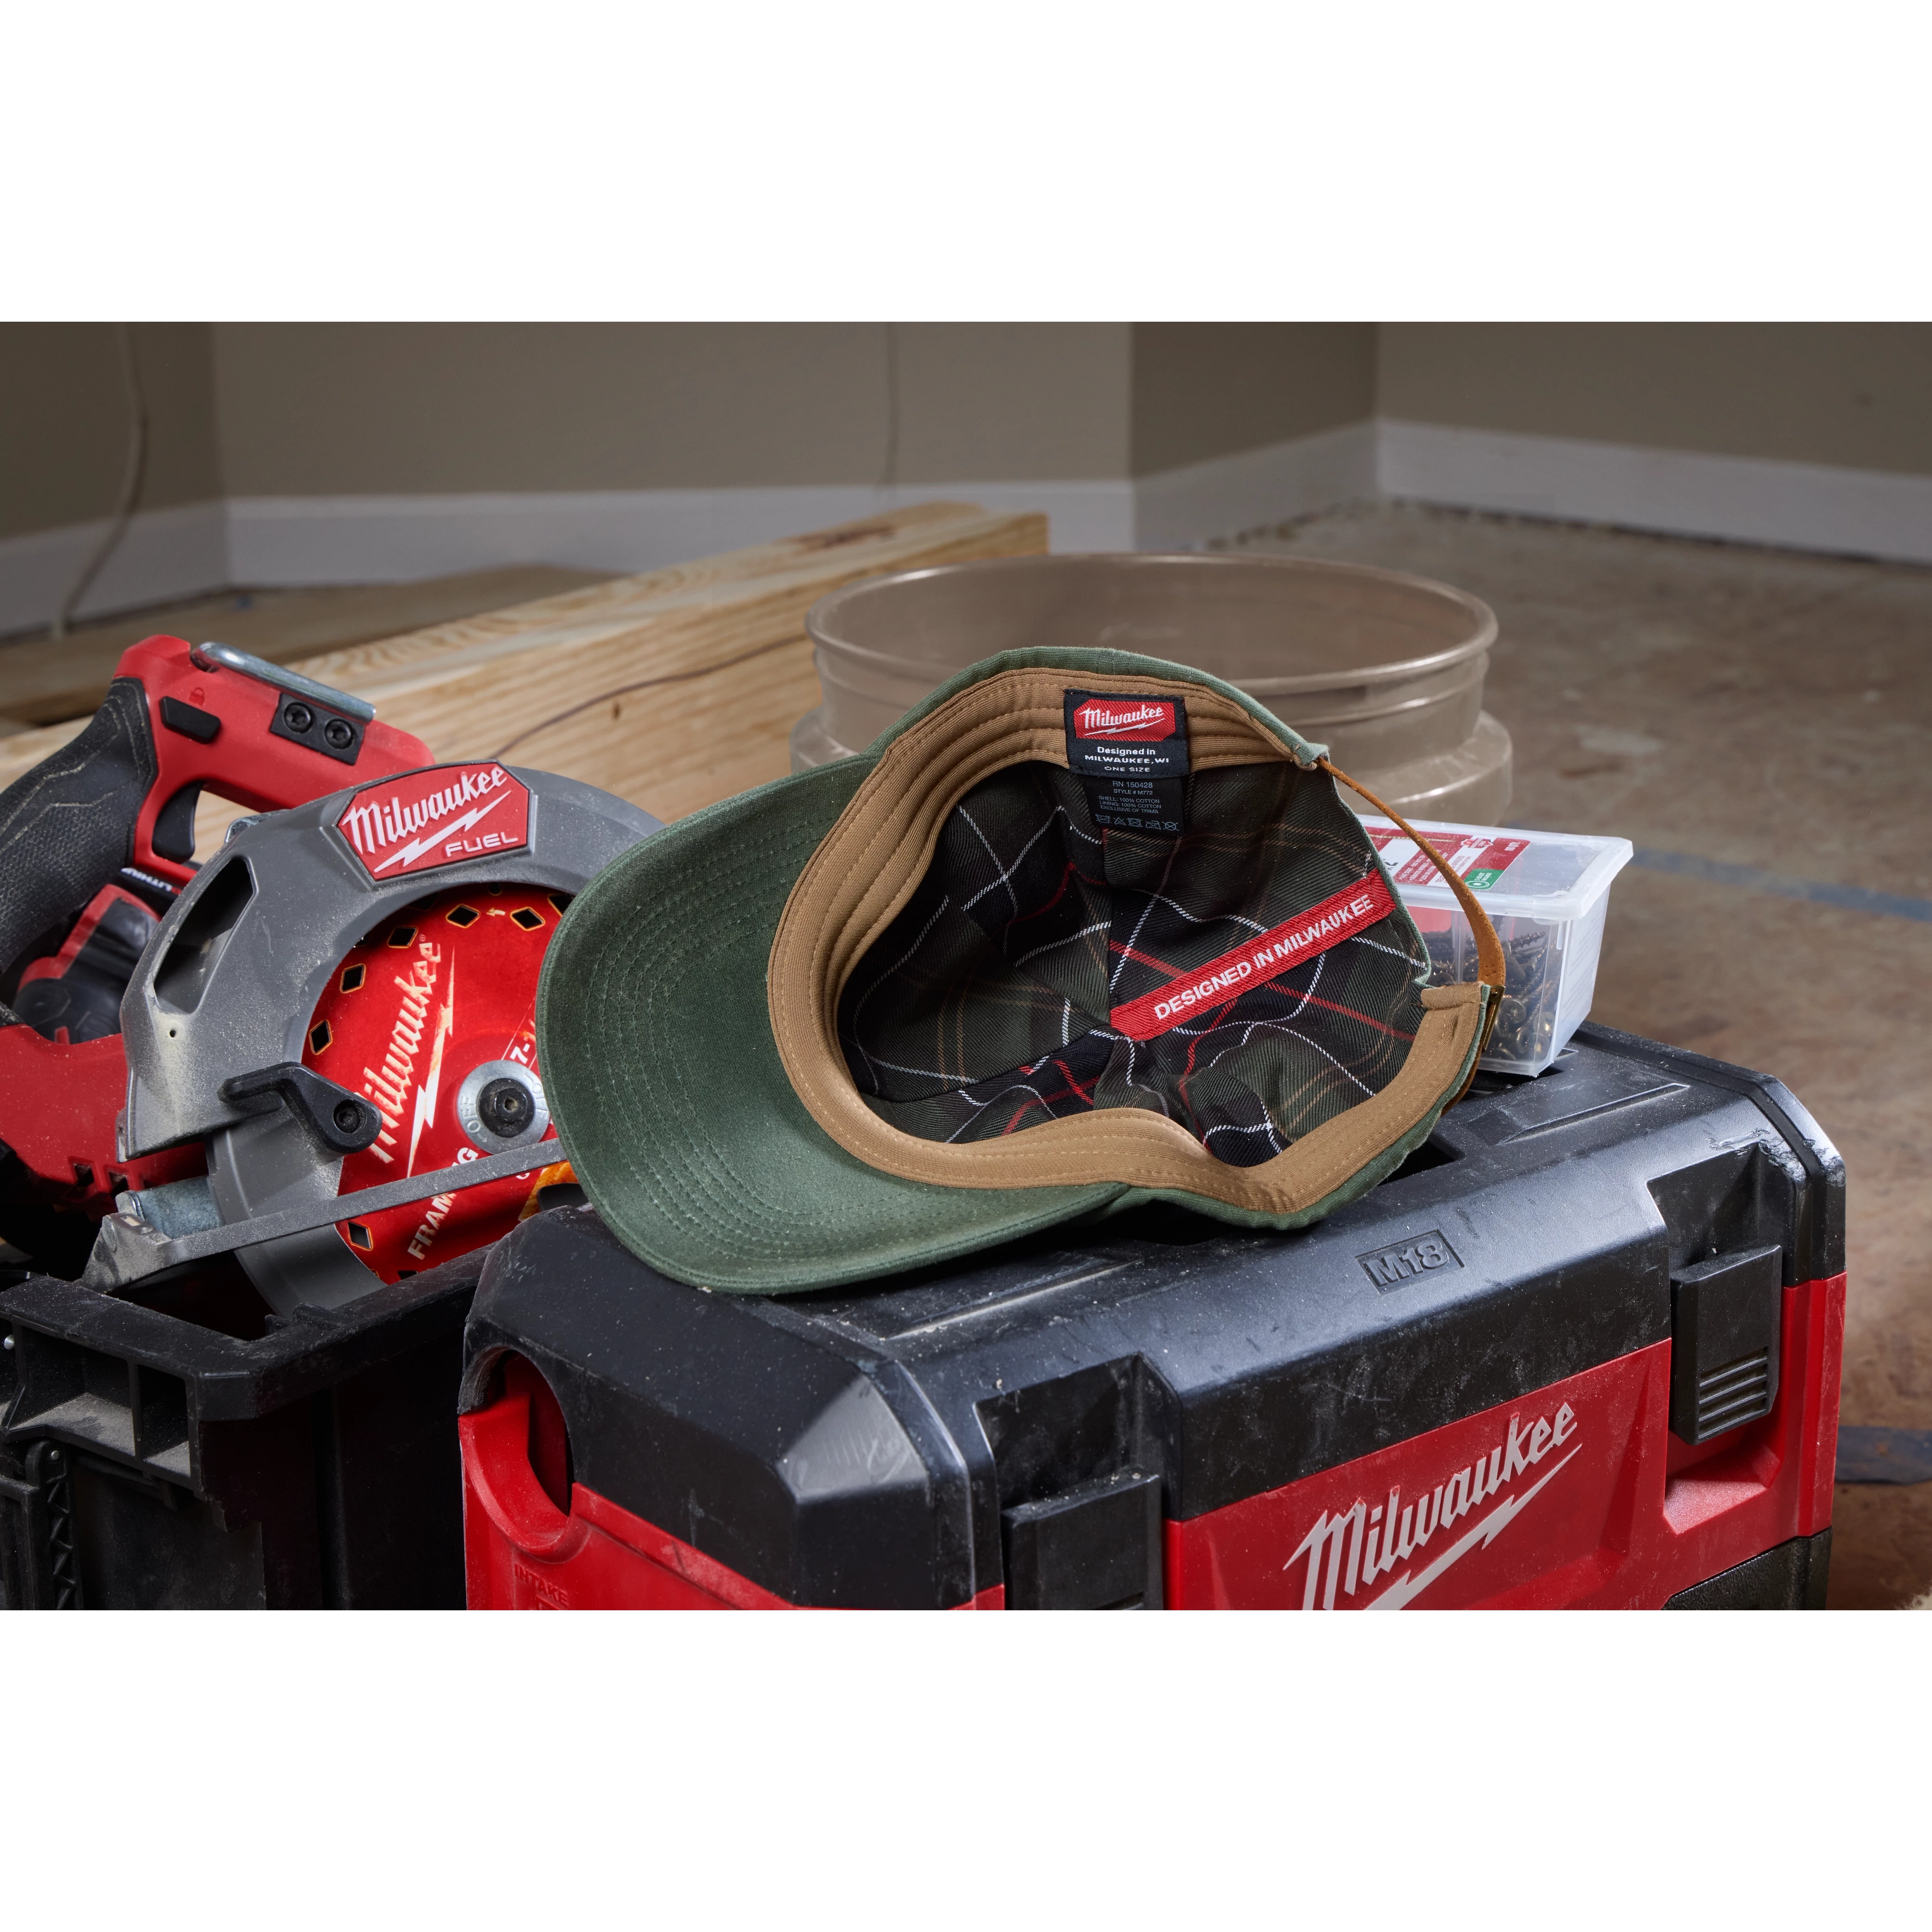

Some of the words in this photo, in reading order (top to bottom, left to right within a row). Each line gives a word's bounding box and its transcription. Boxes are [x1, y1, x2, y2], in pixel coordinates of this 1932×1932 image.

[1079, 705, 1164, 728] Milwaukee
[1097, 747, 1144, 756] Designed
[341, 766, 508, 854] Milwaukee
[445, 834, 518, 857] FUEL
[1153, 961, 1251, 1020] DESIGNED
[1253, 949, 1274, 969] IN
[1273, 894, 1374, 959] MILWAUKEE
[407, 1147, 479, 1261] FRAMG
[1366, 1239, 1450, 1287] M18
[1282, 1402, 1577, 1611] Milwaukee
[514, 1563, 569, 1608] INTAKE
